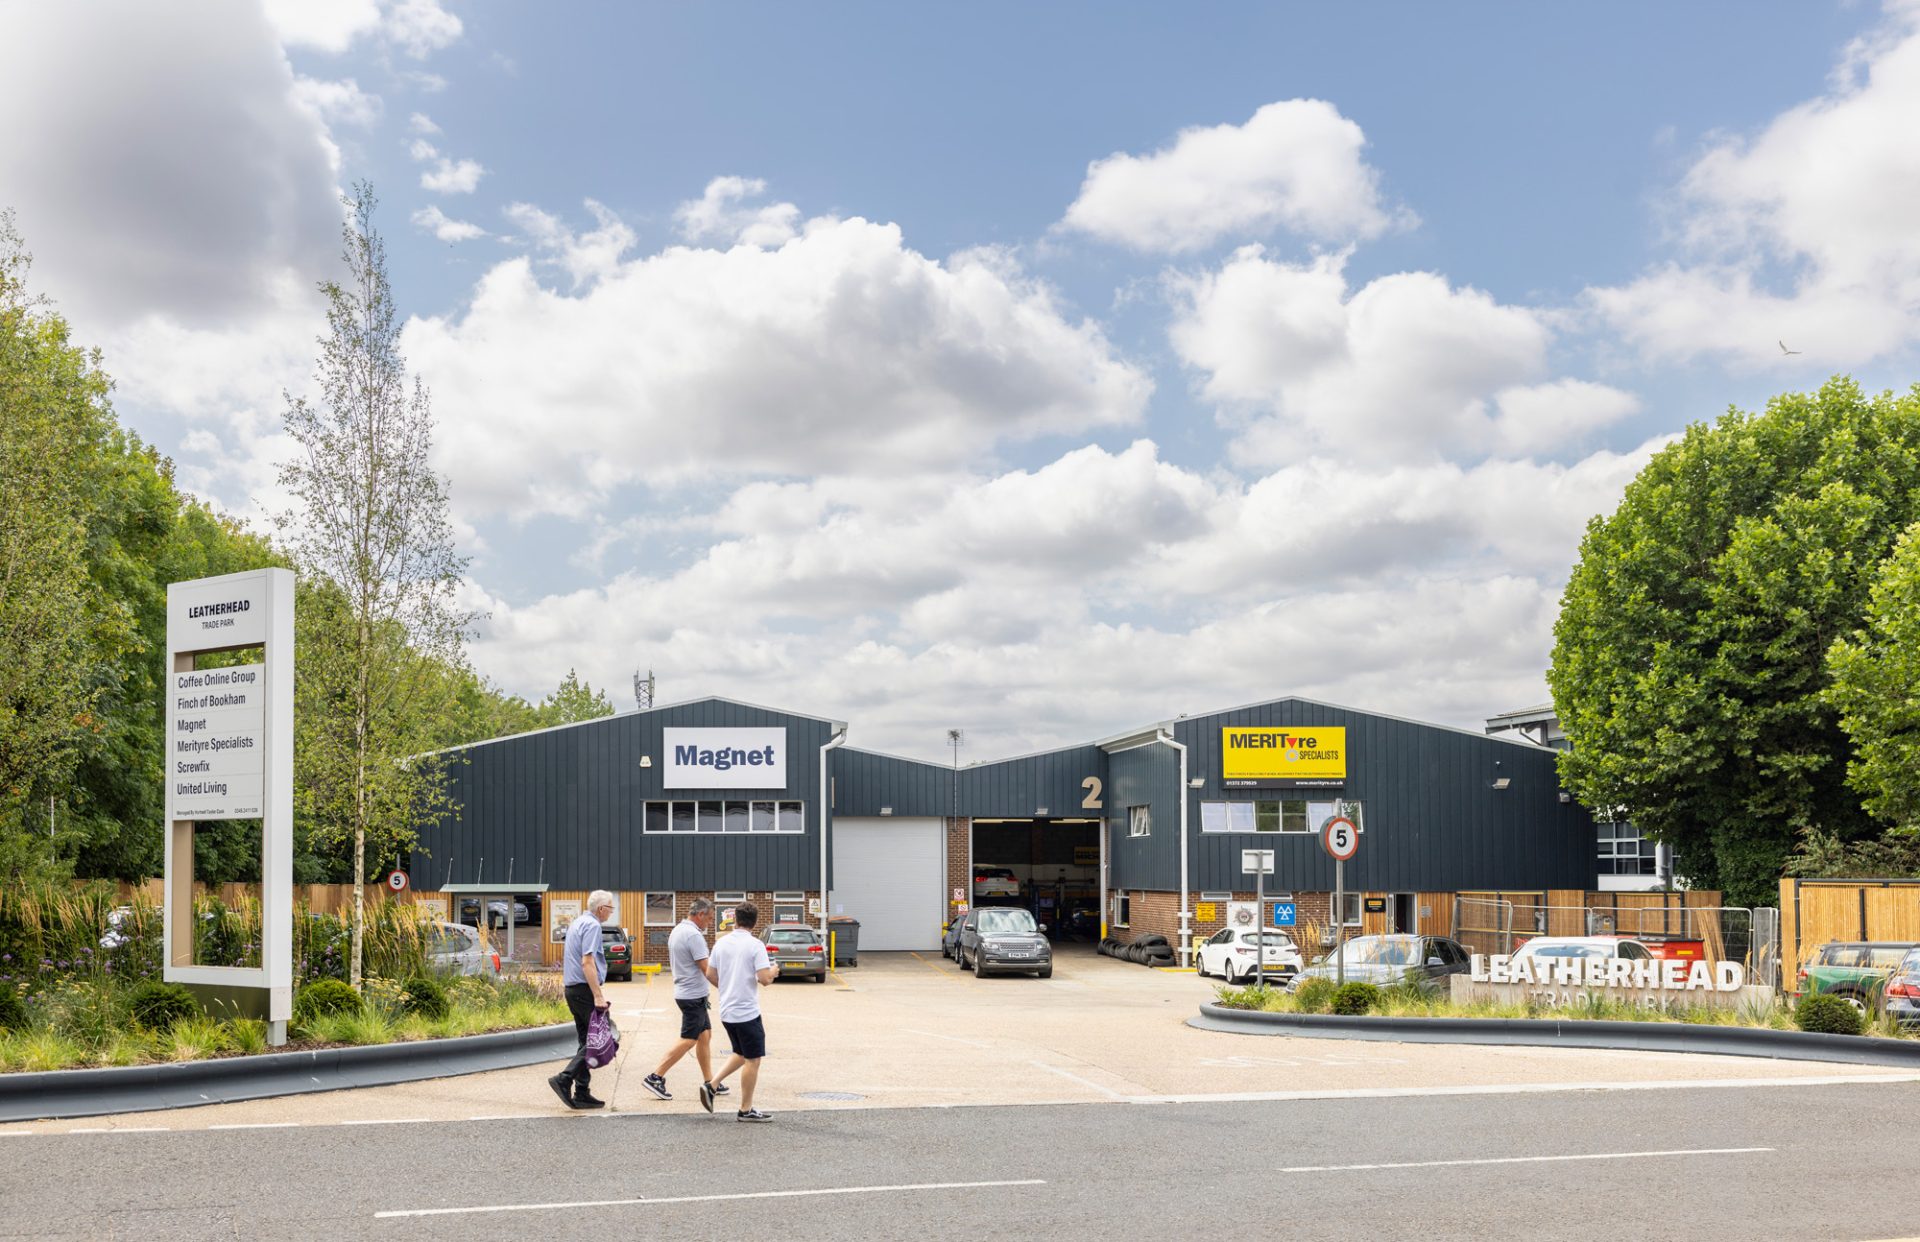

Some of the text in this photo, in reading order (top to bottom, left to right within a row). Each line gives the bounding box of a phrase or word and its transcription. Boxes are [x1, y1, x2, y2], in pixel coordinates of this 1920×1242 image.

[189, 600, 250, 618] LEATHERHEAD
[202, 618, 235, 629] TRADE PARK
[178, 671, 256, 688] Coffee Online Group
[177, 693, 246, 709] Finch of Bookham
[177, 718, 206, 733] Magnet
[177, 736, 254, 754] Merityre Specialists
[675, 745, 775, 770] Magnet
[1299, 750, 1339, 760] SPECIALISTS
[177, 760, 210, 773] Screwfix
[177, 781, 227, 795] United Living
[1081, 776, 1103, 809] 2
[1336, 829, 1347, 848] 5
[393, 875, 401, 886] 5
[1471, 954, 1744, 992] LEATHERHEAD
[1530, 989, 1600, 1010] TRAD
